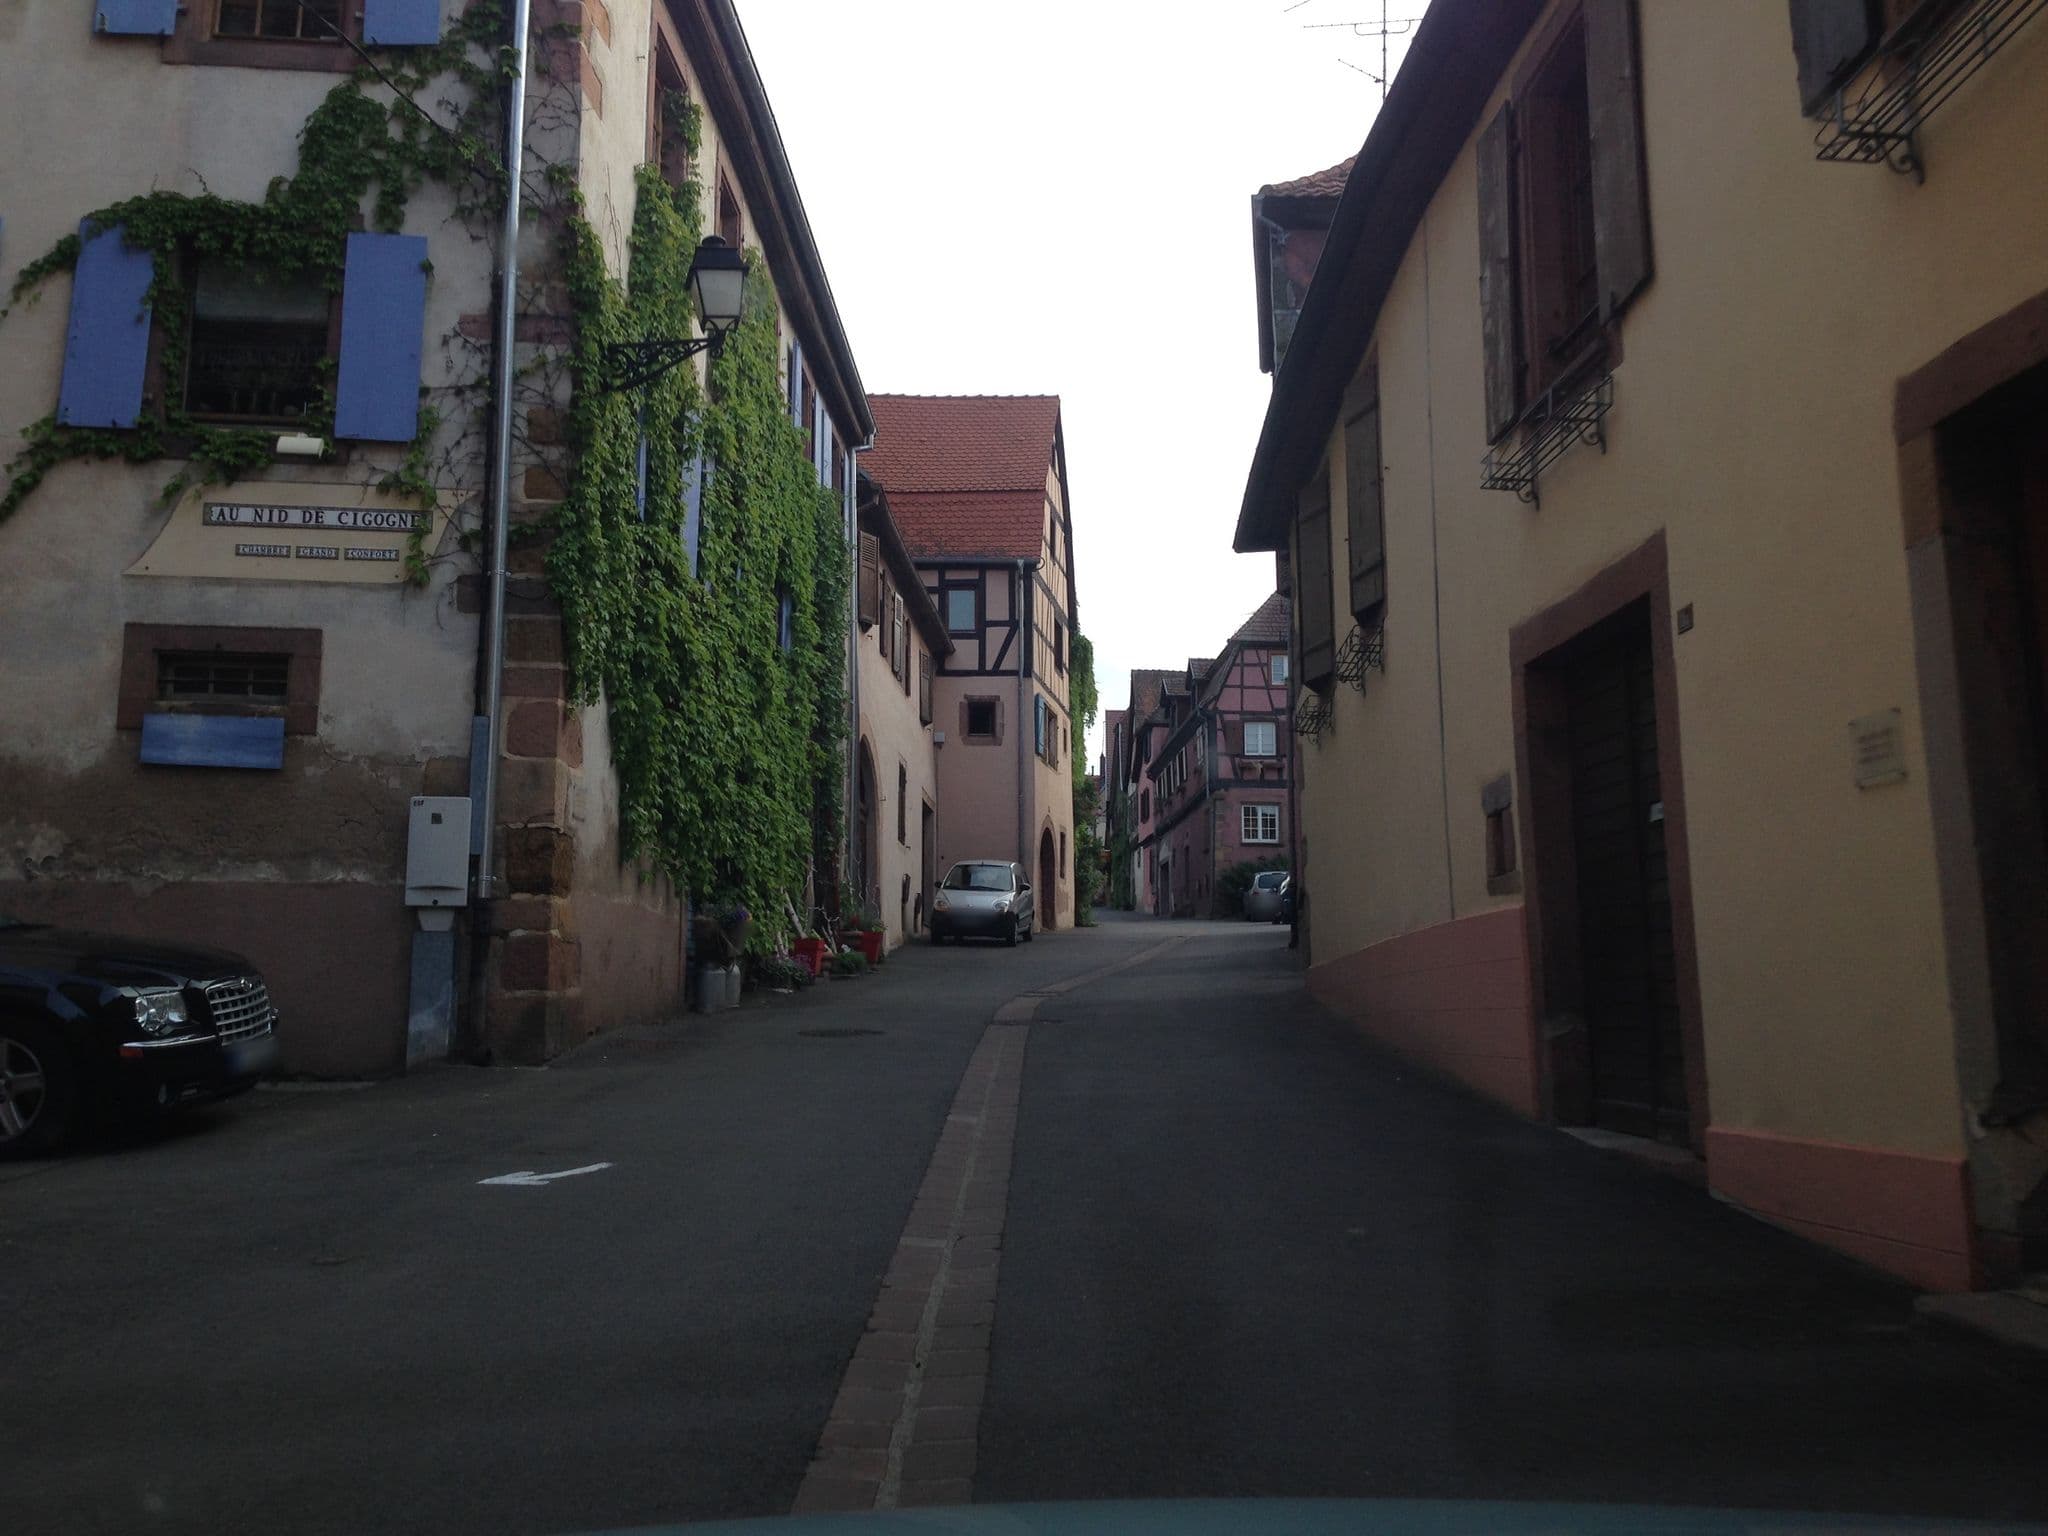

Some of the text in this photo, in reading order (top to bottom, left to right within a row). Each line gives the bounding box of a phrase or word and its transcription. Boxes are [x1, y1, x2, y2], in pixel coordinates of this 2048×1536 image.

[217, 508, 421, 528] AU NID DE CIGOGNE
[302, 547, 333, 557] GRAND
[350, 550, 393, 559] CONFORT
